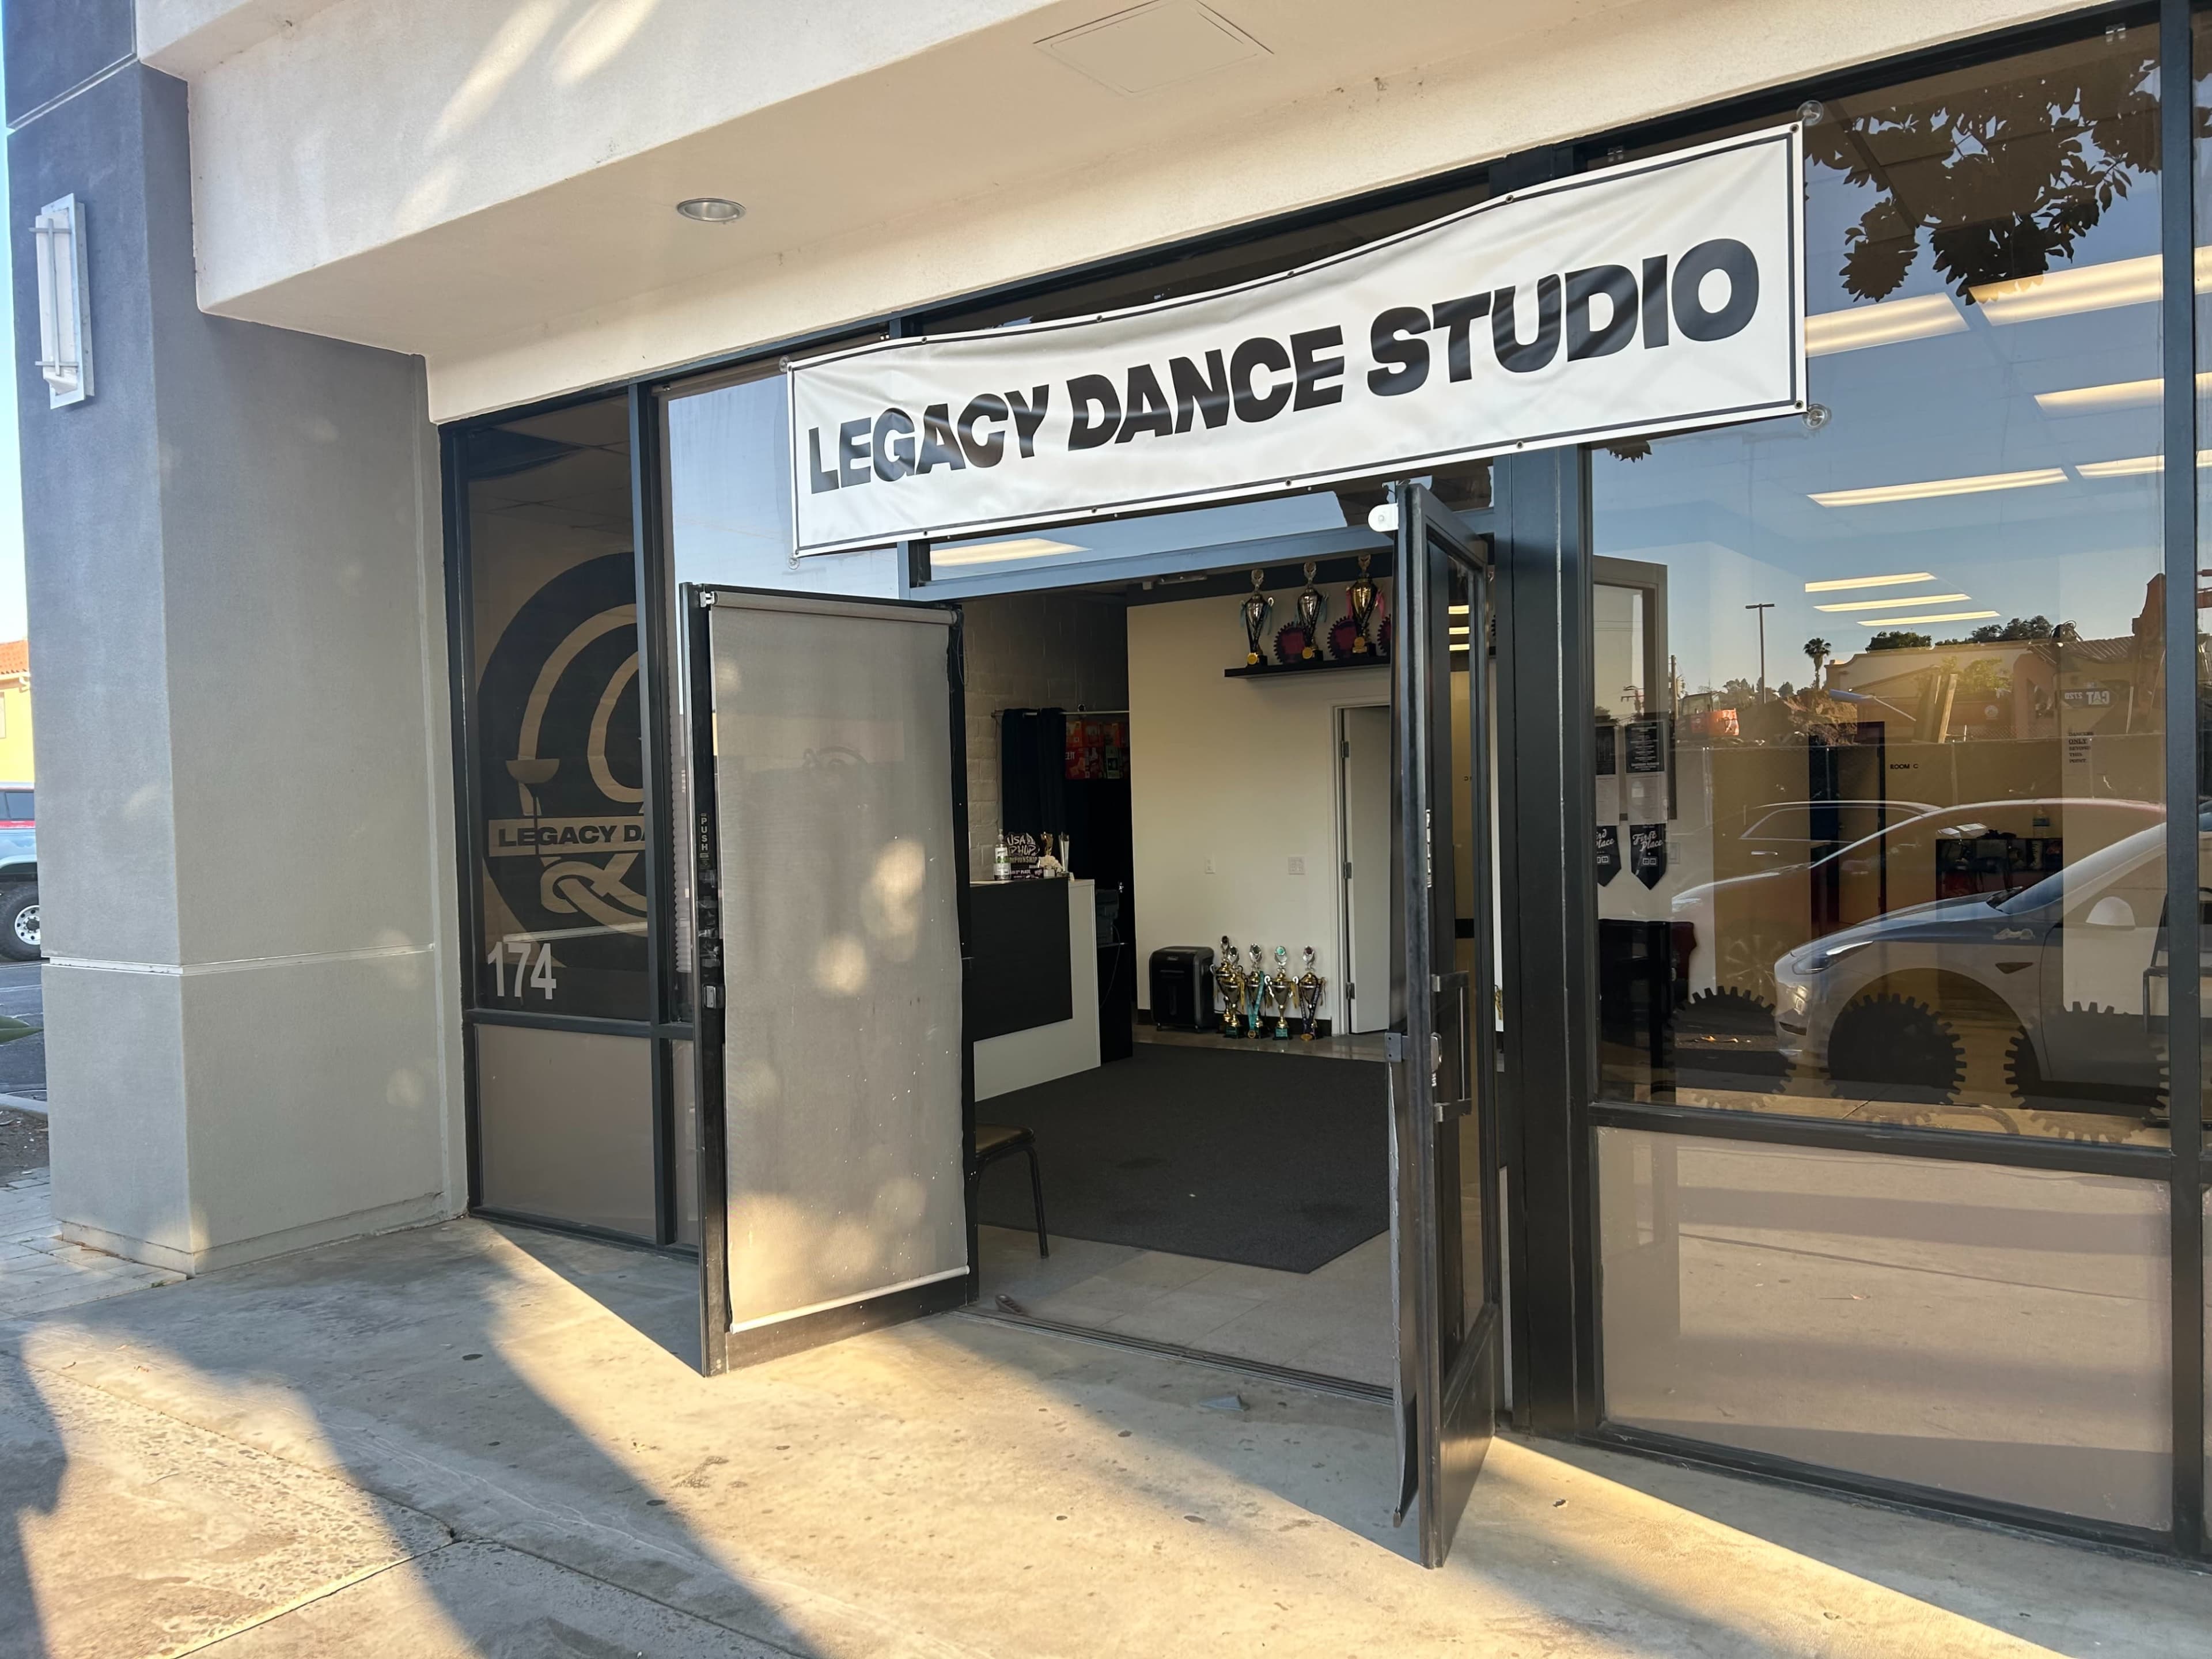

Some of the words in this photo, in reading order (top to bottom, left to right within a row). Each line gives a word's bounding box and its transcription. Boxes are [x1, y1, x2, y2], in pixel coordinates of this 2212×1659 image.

[808, 384, 1050, 494] LEGACY
[1066, 325, 1345, 452] DANCE
[1367, 238, 1760, 397] STUDIO
[498, 825, 618, 847] LEGACY
[624, 824, 645, 842] D
[700, 817, 709, 851] PUSH
[1007, 833, 1025, 846] USA
[1632, 831, 1657, 846] First
[1639, 839, 1664, 852] Place
[488, 941, 556, 999] 174
